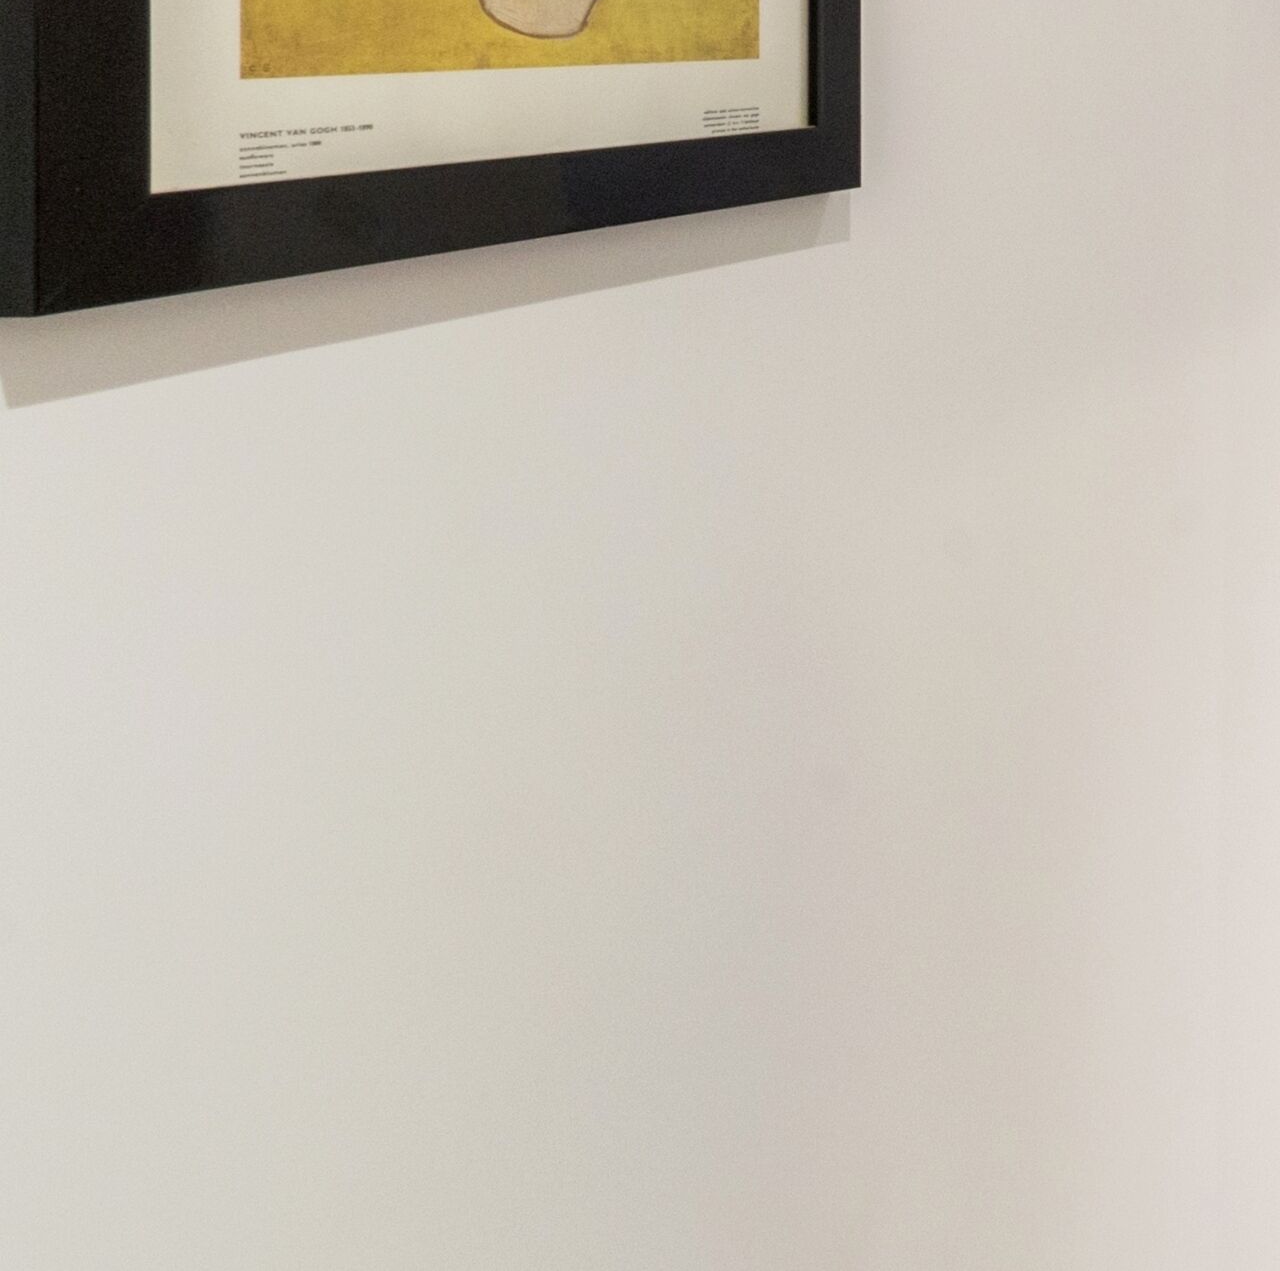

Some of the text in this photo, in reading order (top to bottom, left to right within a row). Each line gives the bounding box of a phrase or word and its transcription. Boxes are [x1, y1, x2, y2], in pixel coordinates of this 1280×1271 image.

[240, 130, 283, 140] VINCENT
[287, 128, 307, 136] VAN
[310, 126, 338, 135] GOGH
